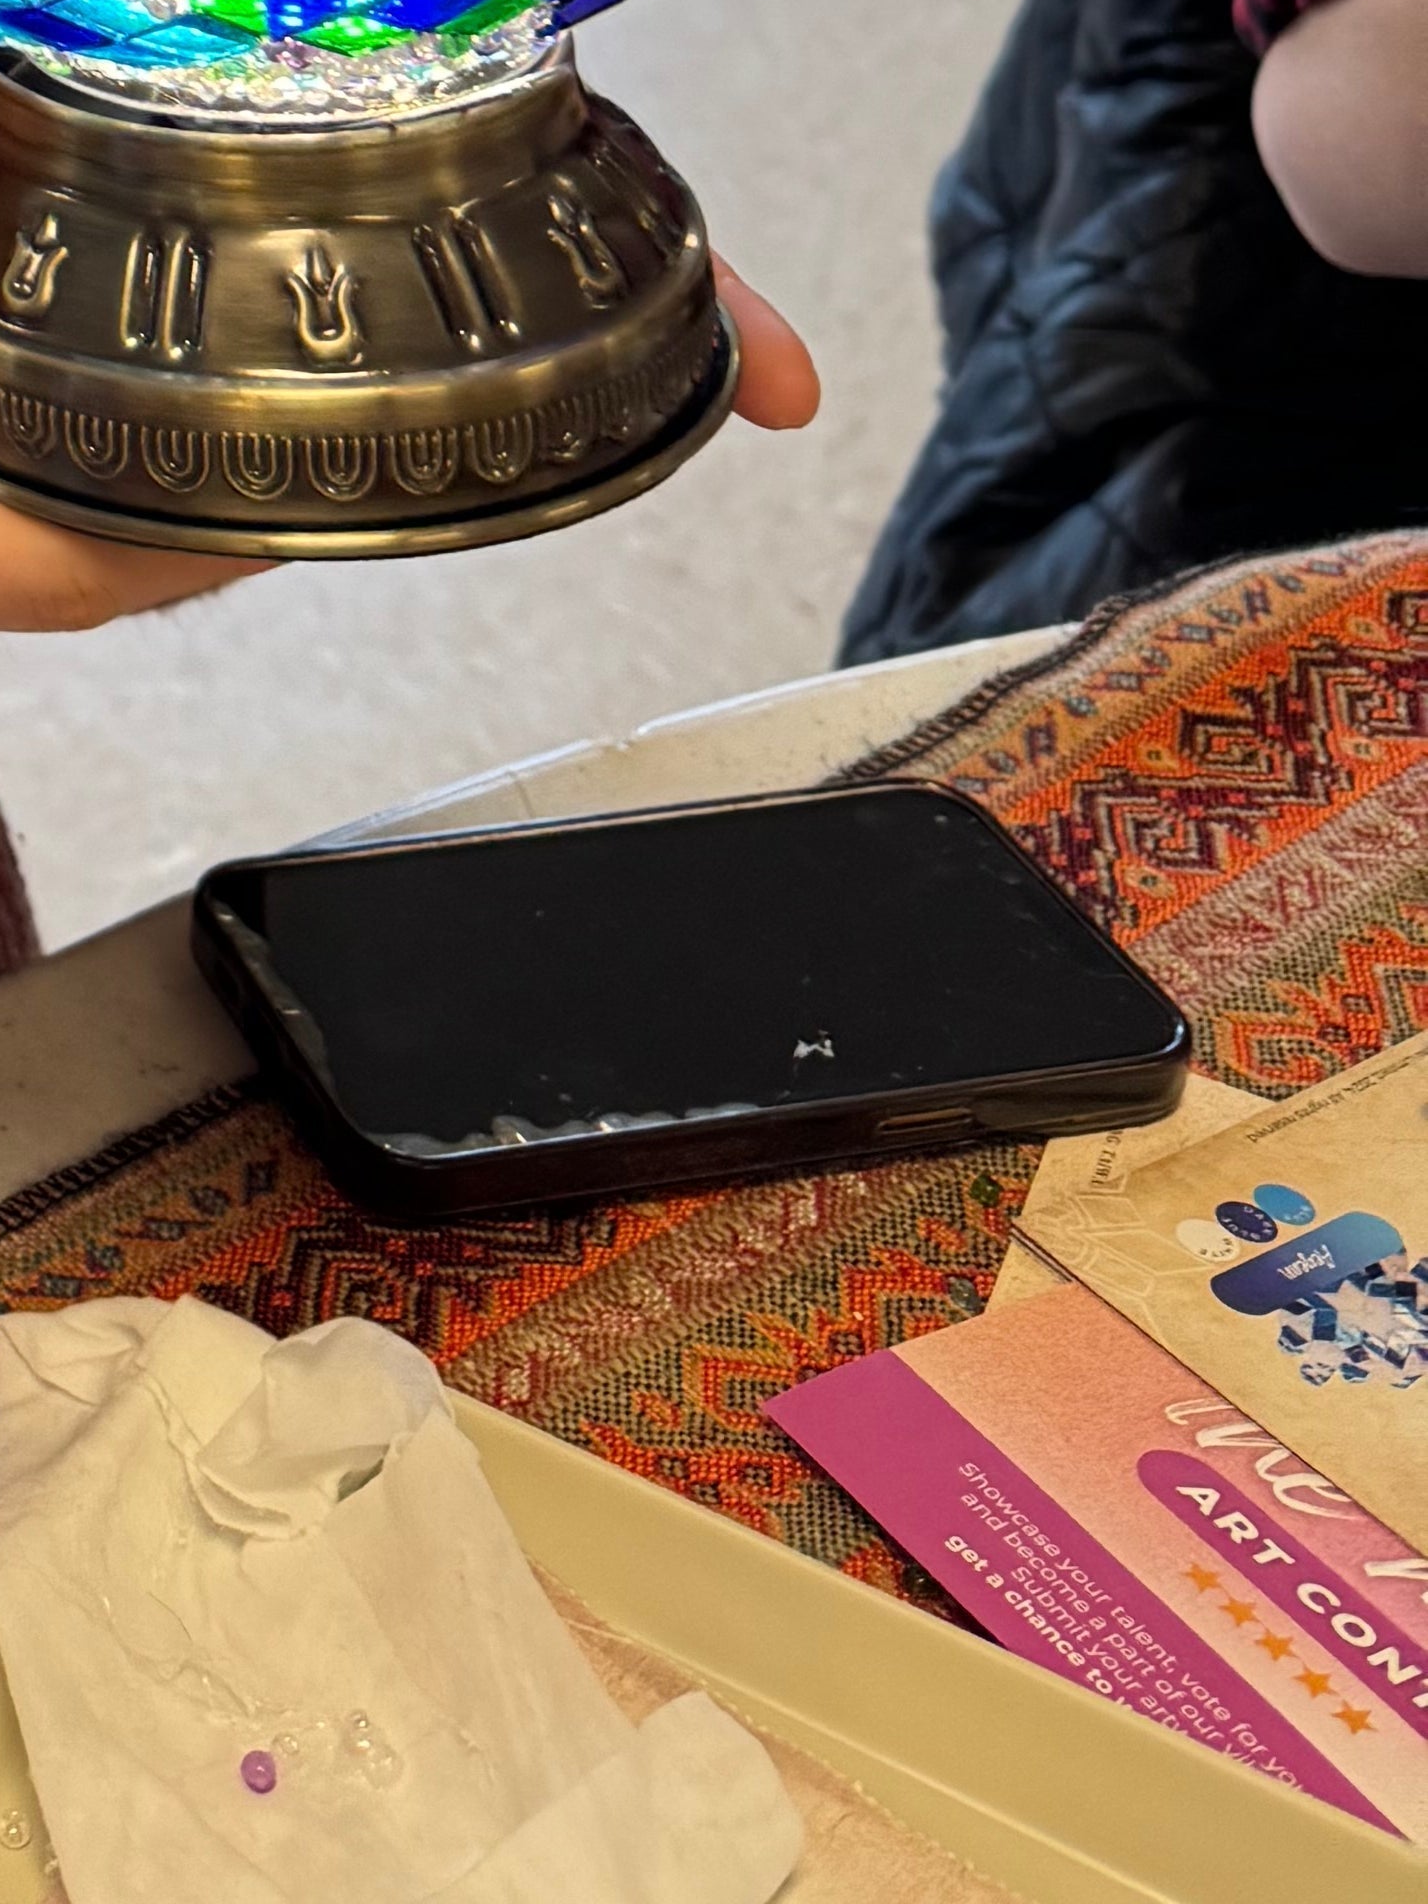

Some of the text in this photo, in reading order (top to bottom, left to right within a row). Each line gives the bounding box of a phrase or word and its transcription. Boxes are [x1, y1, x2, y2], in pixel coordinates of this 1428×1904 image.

[1276, 1244, 1336, 1280] Aegean
[1175, 1485, 1296, 1565] ART
[944, 1535, 1114, 1694] get a chance to
[958, 1462, 1061, 1557] Showcase
[1054, 1558, 1113, 1604] your
[1110, 1606, 1177, 1673] talent,
[1181, 1672, 1232, 1721] vote
[1230, 1723, 1269, 1753] for
[960, 1493, 1010, 1531] and
[1003, 1531, 1090, 1613] become
[1088, 1615, 1107, 1630] a
[1101, 1633, 1156, 1677] part
[1155, 1679, 1188, 1701] of
[1181, 1704, 1225, 1740] our
[1010, 1566, 1092, 1642] Submit
[1083, 1643, 1143, 1691] your
